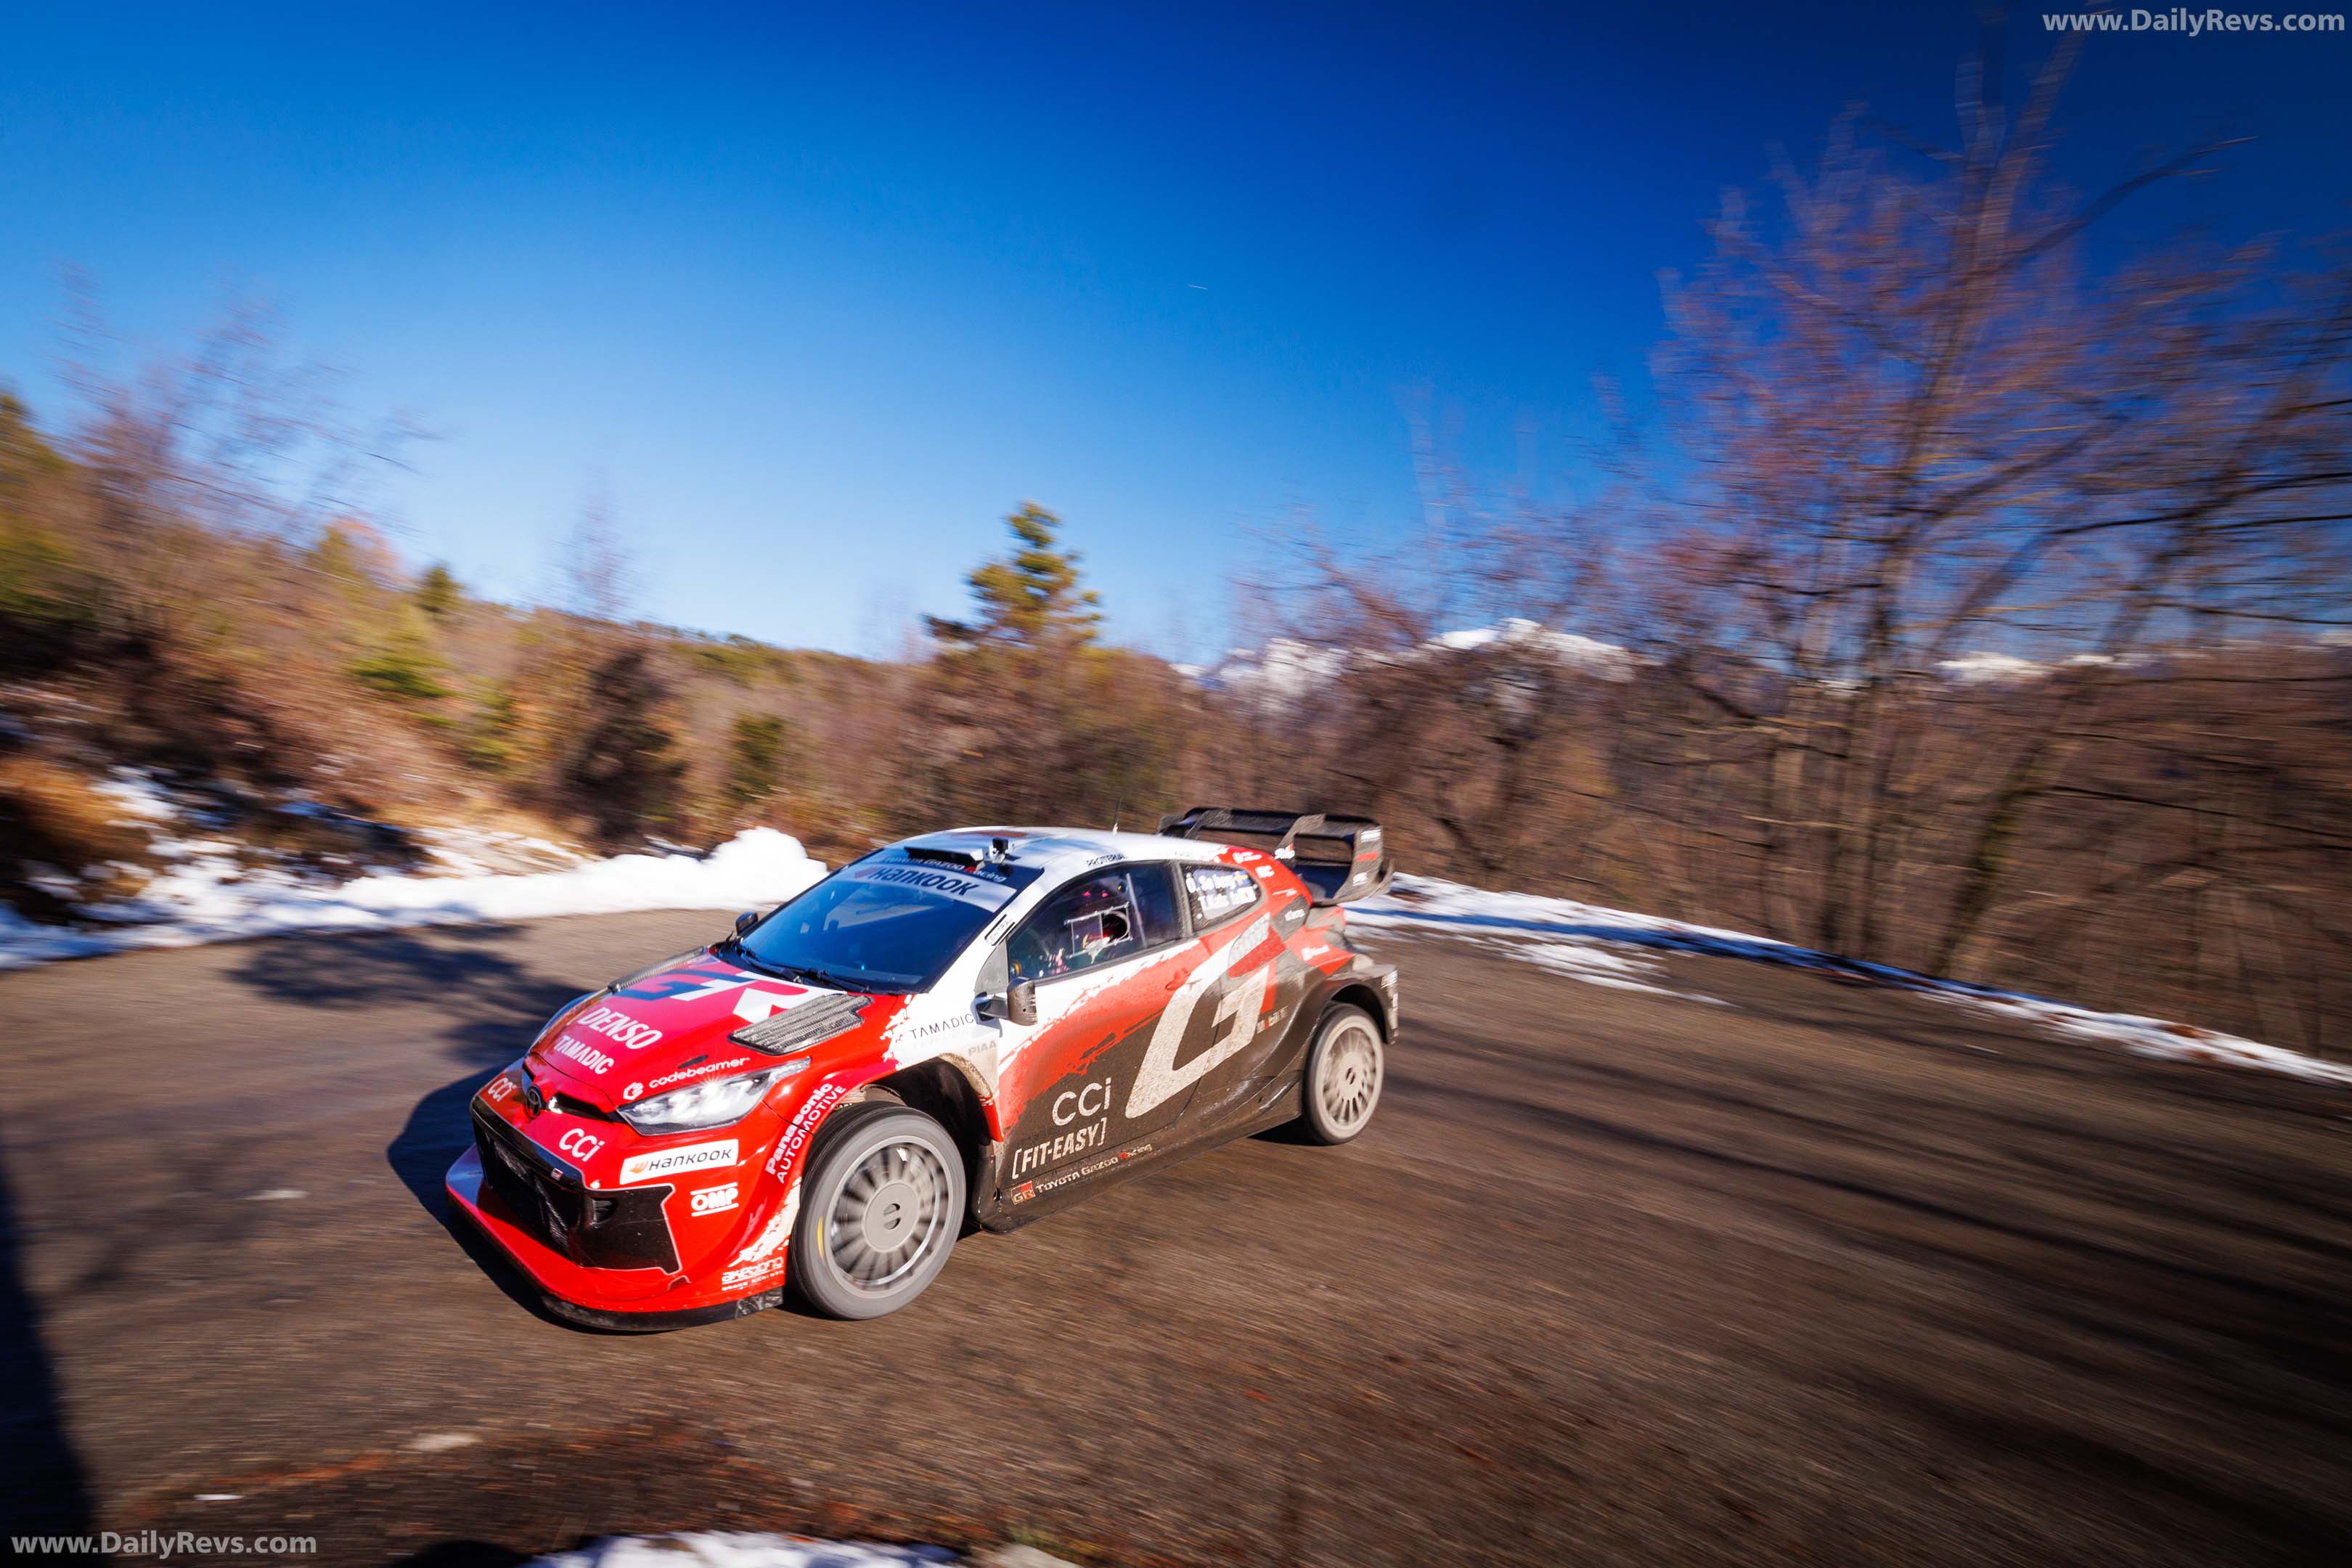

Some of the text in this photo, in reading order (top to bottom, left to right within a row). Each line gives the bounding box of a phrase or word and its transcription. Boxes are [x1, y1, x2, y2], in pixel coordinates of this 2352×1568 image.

[577, 1007, 663, 1050] DENSO
[910, 1013, 974, 1040] TAMADIC
[554, 1034, 615, 1075] TAMADIC
[968, 1040, 997, 1058] PIAA
[649, 1057, 747, 1088] codebeamer
[764, 1083, 833, 1175] Panasonic
[777, 1085, 846, 1184] AUTOMOTIVE
[1035, 1171, 1080, 1193] TOYOTA
[690, 1187, 739, 1212] OMP
